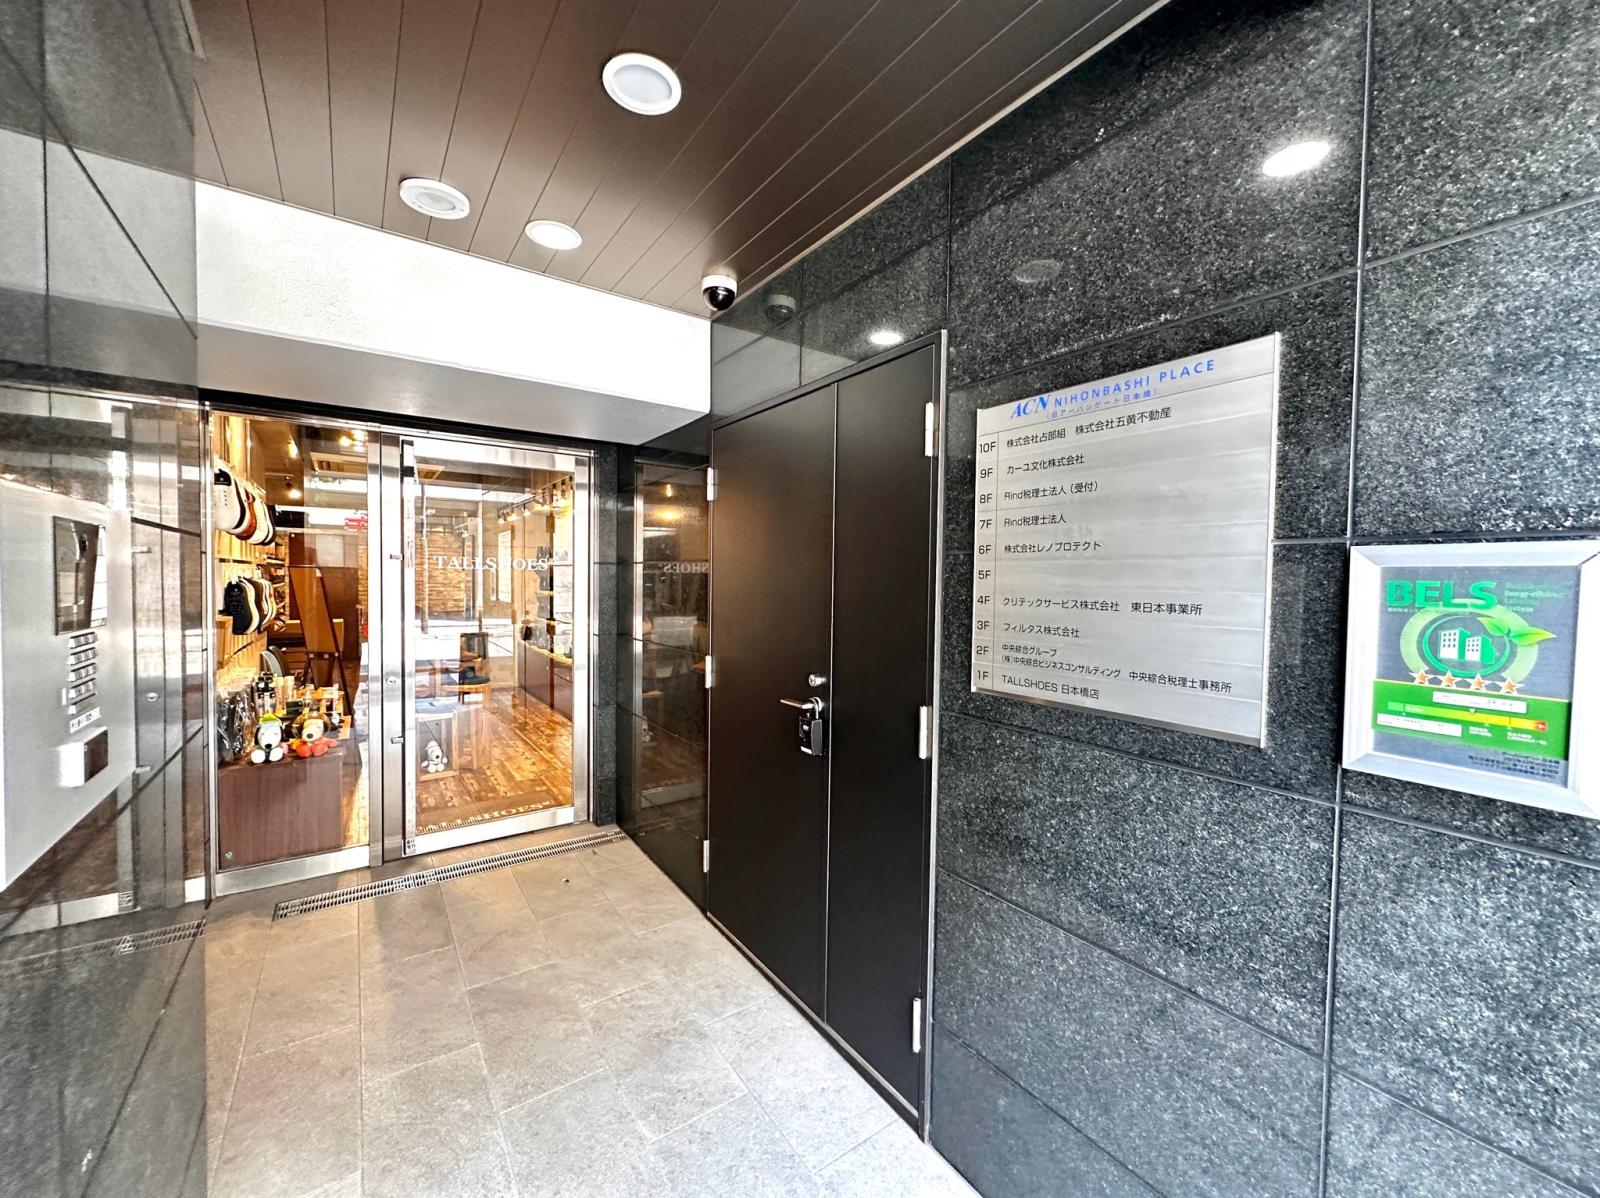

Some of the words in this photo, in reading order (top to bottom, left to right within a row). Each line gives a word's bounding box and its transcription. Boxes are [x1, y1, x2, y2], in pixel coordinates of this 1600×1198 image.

[1010, 395, 1052, 419] ACN
[1055, 376, 1150, 406] NIHONBASHI
[1159, 359, 1216, 381] PLACE
[1006, 428, 1066, 449] 株式会社占部組
[1075, 406, 1173, 436] 株式会社五黄不動産
[979, 441, 997, 454] 10F
[1006, 453, 1085, 475] カーユ文化株式会社
[980, 468, 994, 479] 9F
[979, 493, 993, 504] 8F
[979, 519, 993, 529] 7F
[1004, 513, 1067, 527] Rind税理士法人
[978, 544, 992, 555] 6F
[1004, 540, 1102, 554] 株式会社レノプロテクト
[432, 555, 549, 571] TALLSOES
[978, 570, 991, 580] 5F
[977, 596, 991, 605] 4F
[1386, 580, 1498, 610] BELS
[1002, 597, 1120, 612] クリテックサービス株式会社
[1130, 602, 1203, 616] 東日本事業所
[976, 621, 990, 630] 3F
[1003, 622, 1080, 638] フィルタス株式会社
[976, 645, 990, 655] 2F
[977, 670, 989, 681] 1F
[1002, 675, 1058, 693] TALLSHOES
[1061, 684, 1100, 699] 日本橋店
